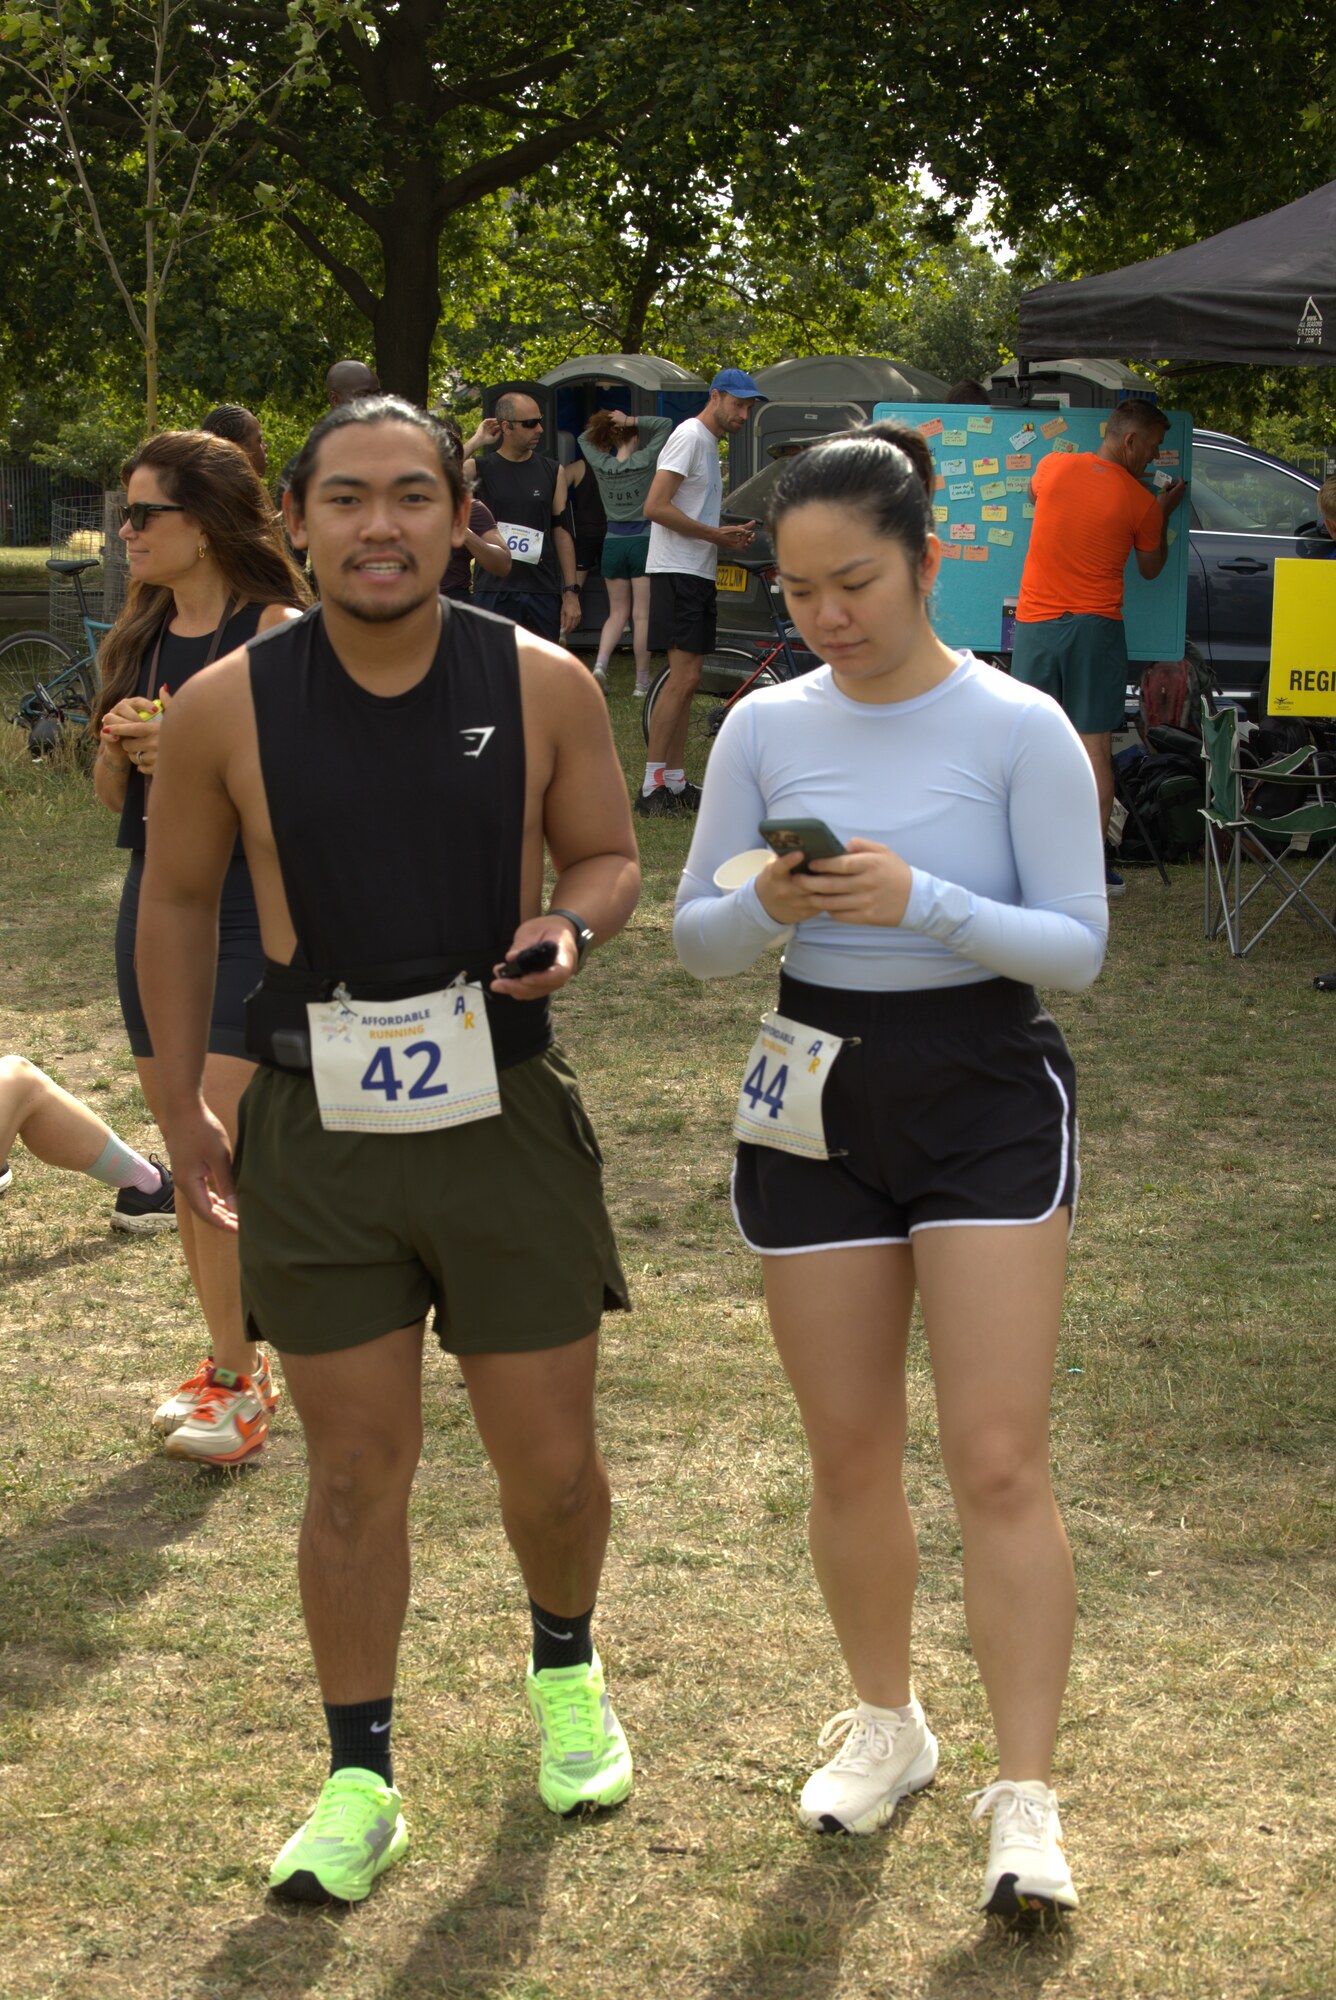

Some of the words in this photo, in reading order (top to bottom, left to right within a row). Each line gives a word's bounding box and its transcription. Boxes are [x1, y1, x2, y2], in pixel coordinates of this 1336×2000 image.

[1297, 328, 1322, 336] GAZEBOS
[507, 535, 530, 553] 66
[1289, 669, 1336, 692] REGI
[361, 1009, 431, 1026] AFFORDABLE
[369, 1024, 425, 1039] RUNNING
[360, 1040, 449, 1101] 42
[743, 1054, 789, 1119] 44
